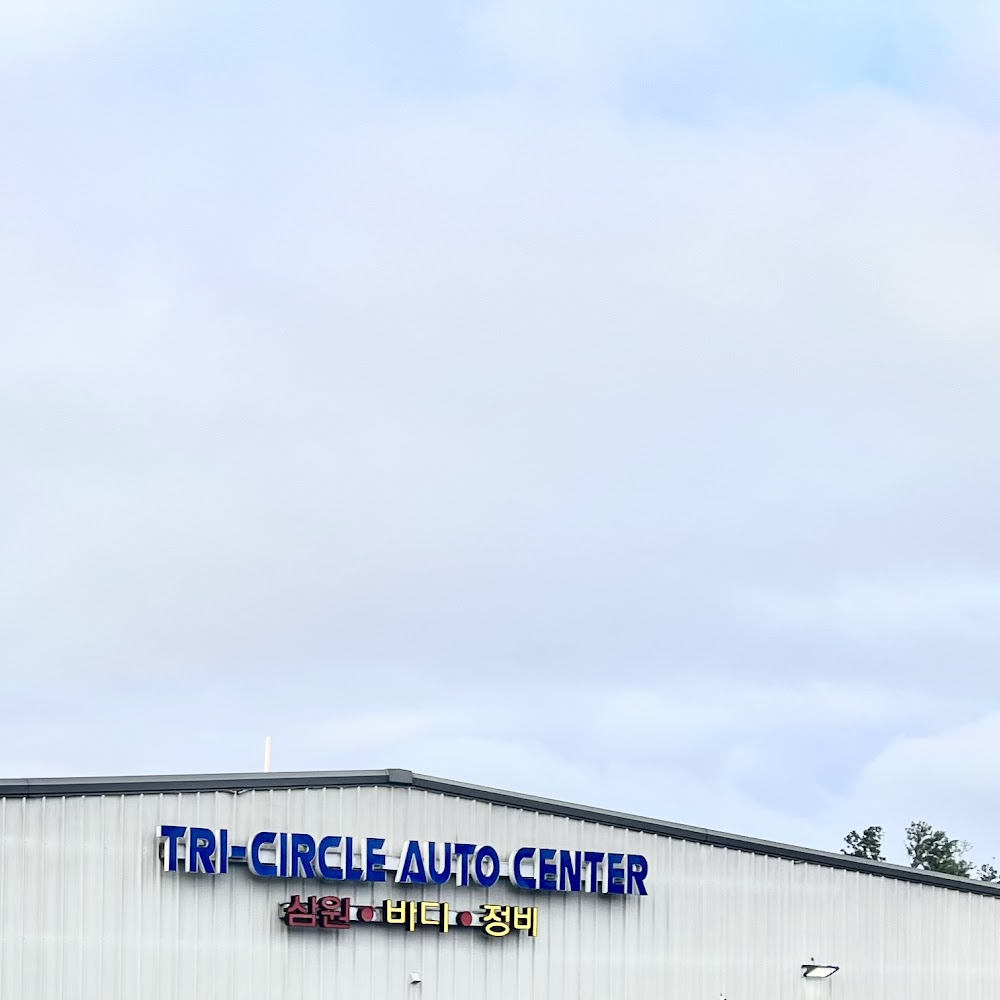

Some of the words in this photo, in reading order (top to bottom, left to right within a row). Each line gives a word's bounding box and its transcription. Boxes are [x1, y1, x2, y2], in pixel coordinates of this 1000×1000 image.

[157, 825, 386, 882] TRI-CIRCLE
[396, 840, 500, 888] AUTO
[510, 847, 648, 895] CENTER
[286, 894, 350, 929] 삼원
[384, 899, 449, 933] 바디
[484, 904, 538, 937] 정비
